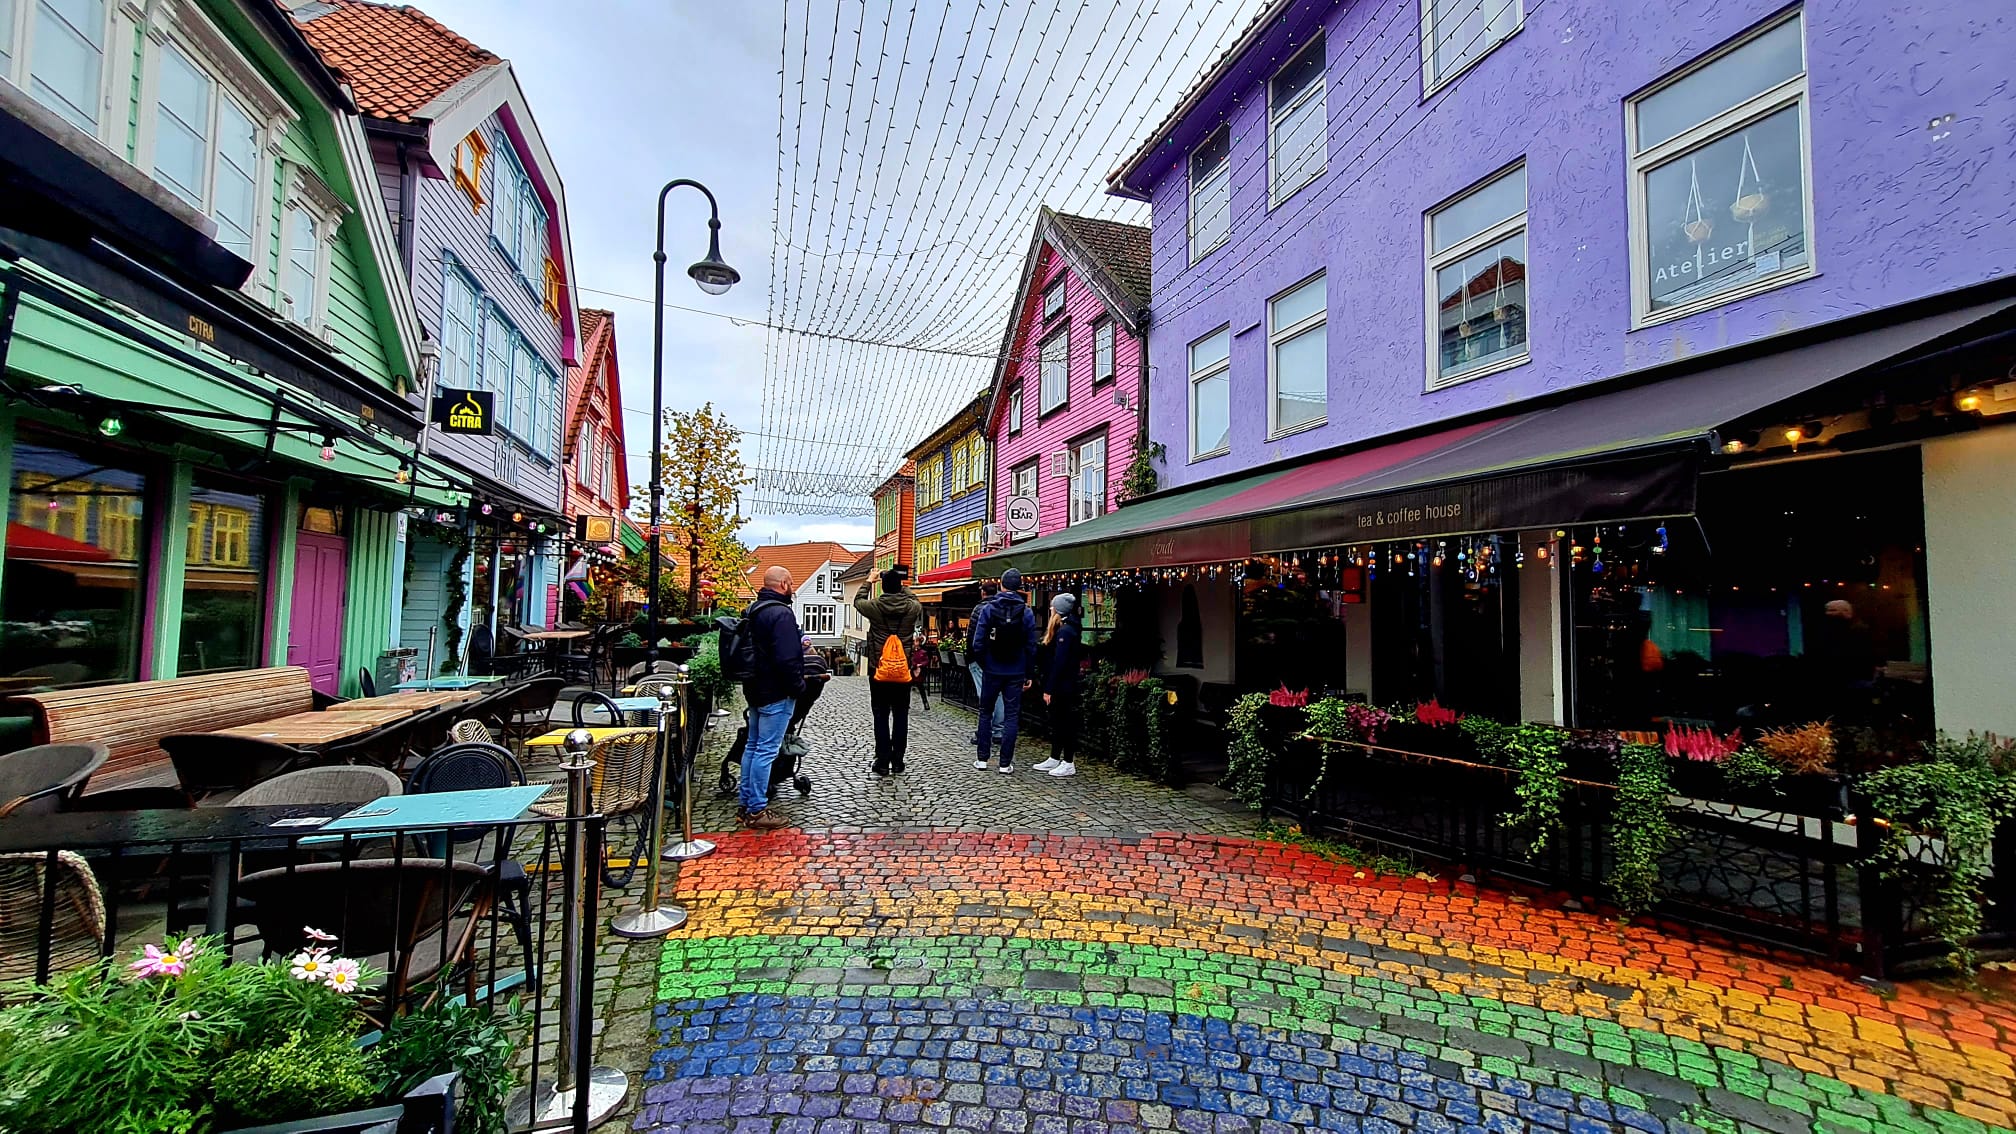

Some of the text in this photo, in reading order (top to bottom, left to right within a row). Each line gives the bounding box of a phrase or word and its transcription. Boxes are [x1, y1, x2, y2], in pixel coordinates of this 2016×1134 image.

[1655, 240, 1748, 283] Atelier
[1011, 508, 1033, 520] BAR
[1357, 503, 1461, 528] tea & coffee house
